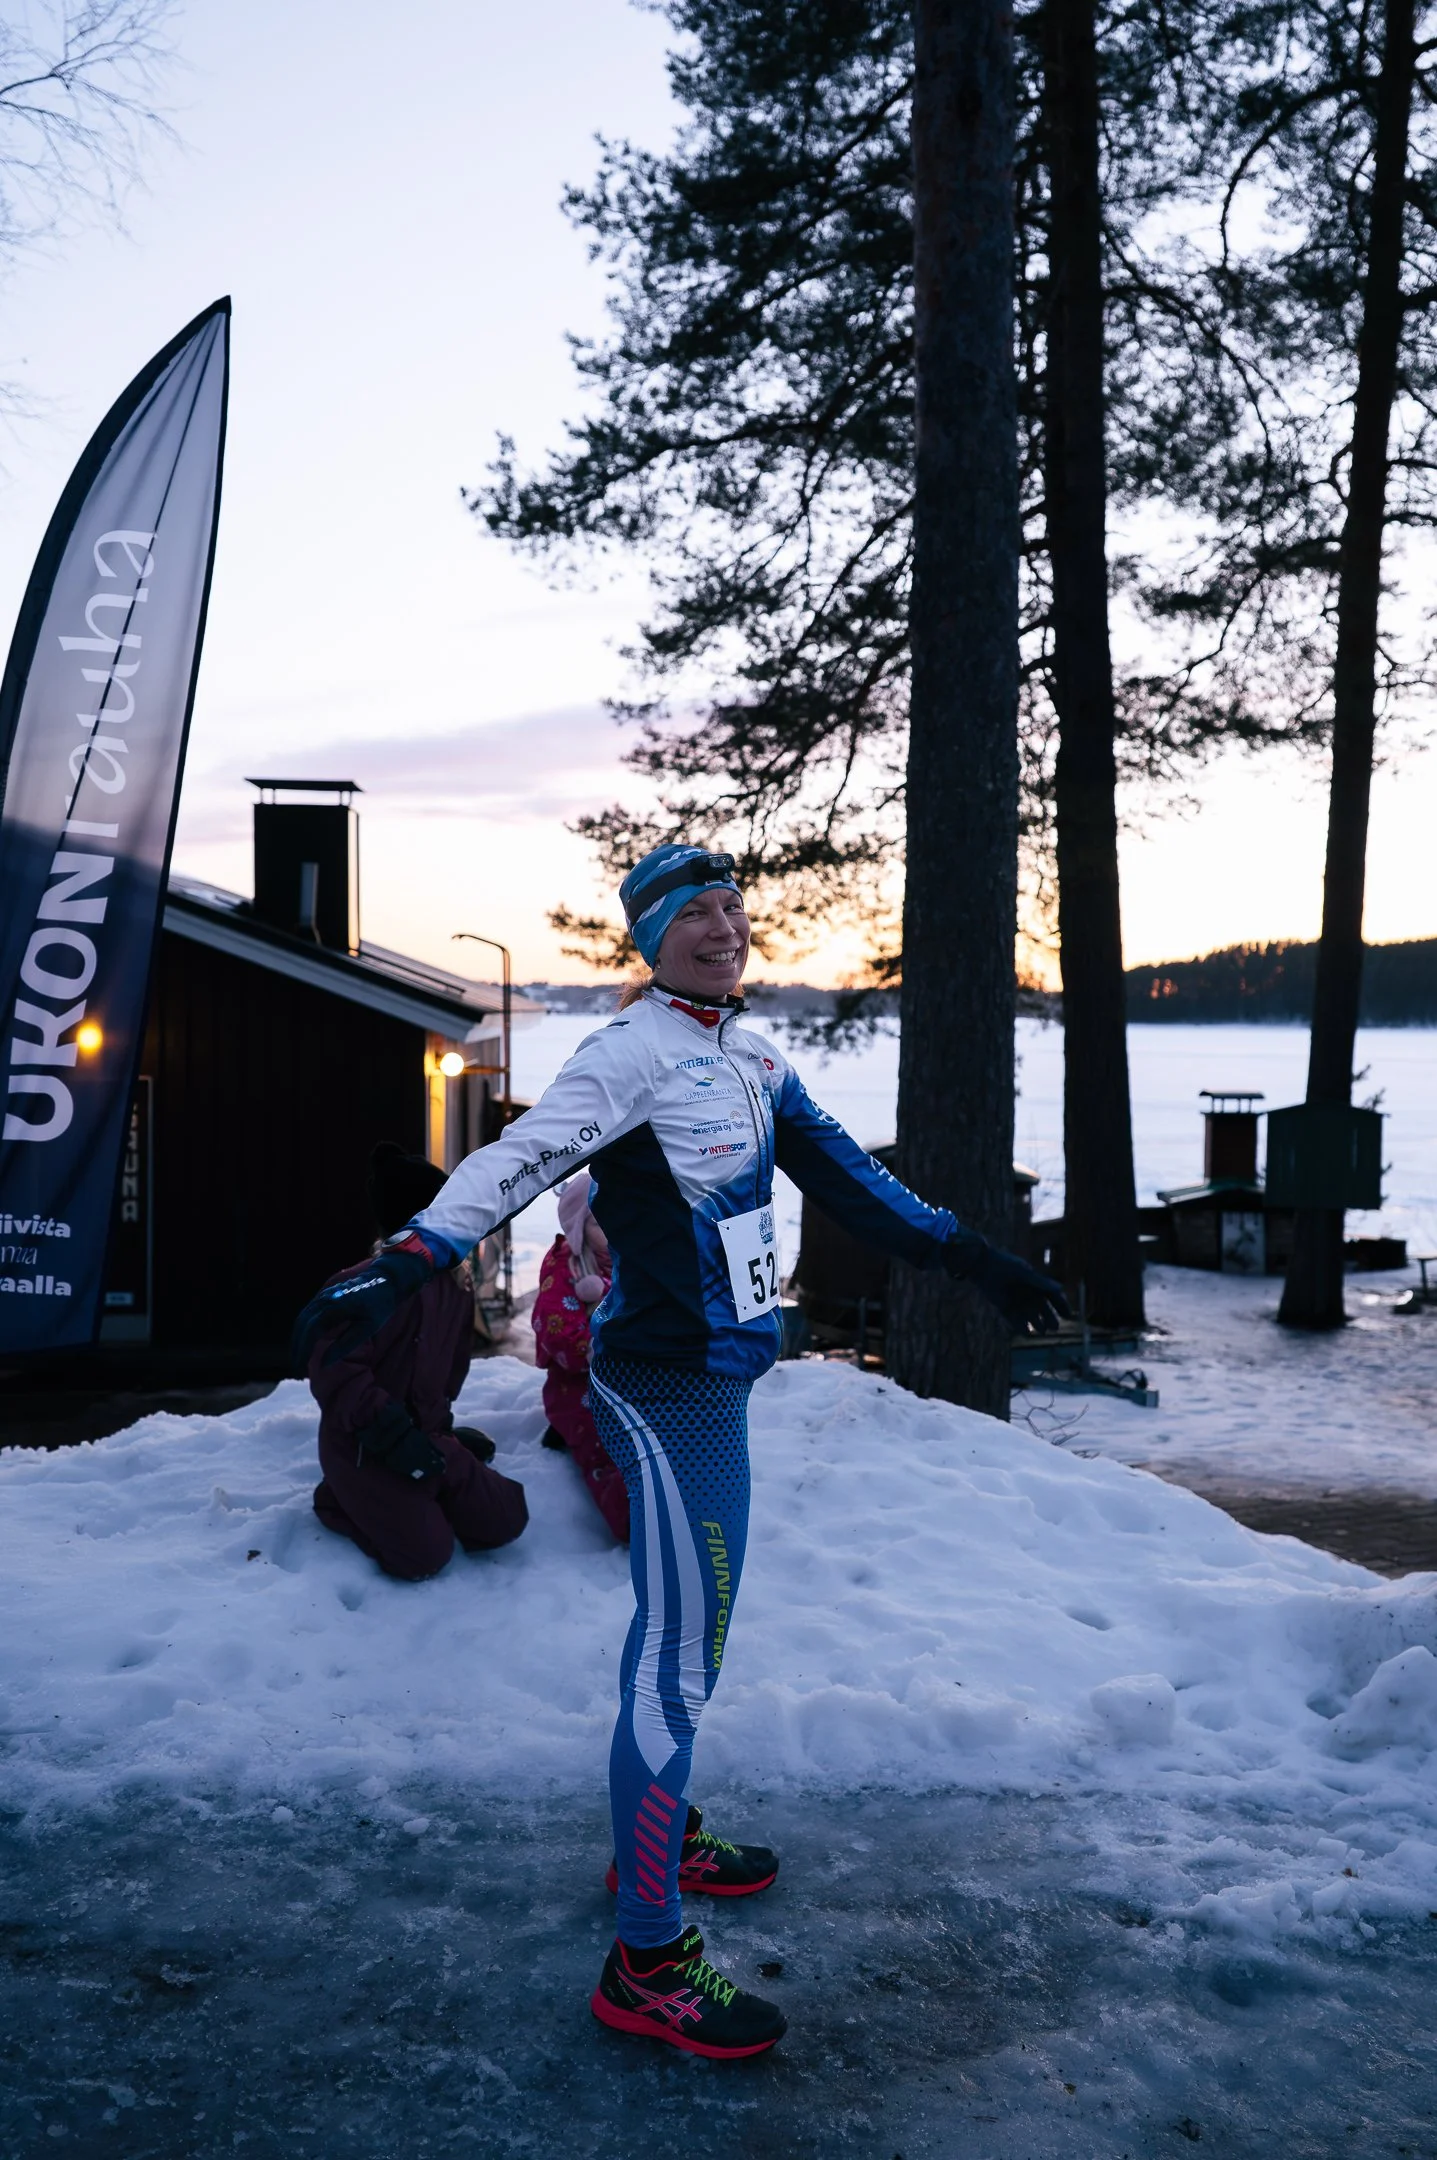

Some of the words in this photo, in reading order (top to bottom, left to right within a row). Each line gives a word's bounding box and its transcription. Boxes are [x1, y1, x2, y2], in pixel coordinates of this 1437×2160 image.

[579, 1120, 602, 1142] Oy
[692, 1125, 723, 1135] energia
[708, 1142, 748, 1155] INTERSPORT
[0, 1275, 72, 1296] aalla
[747, 1251, 778, 1305] 52
